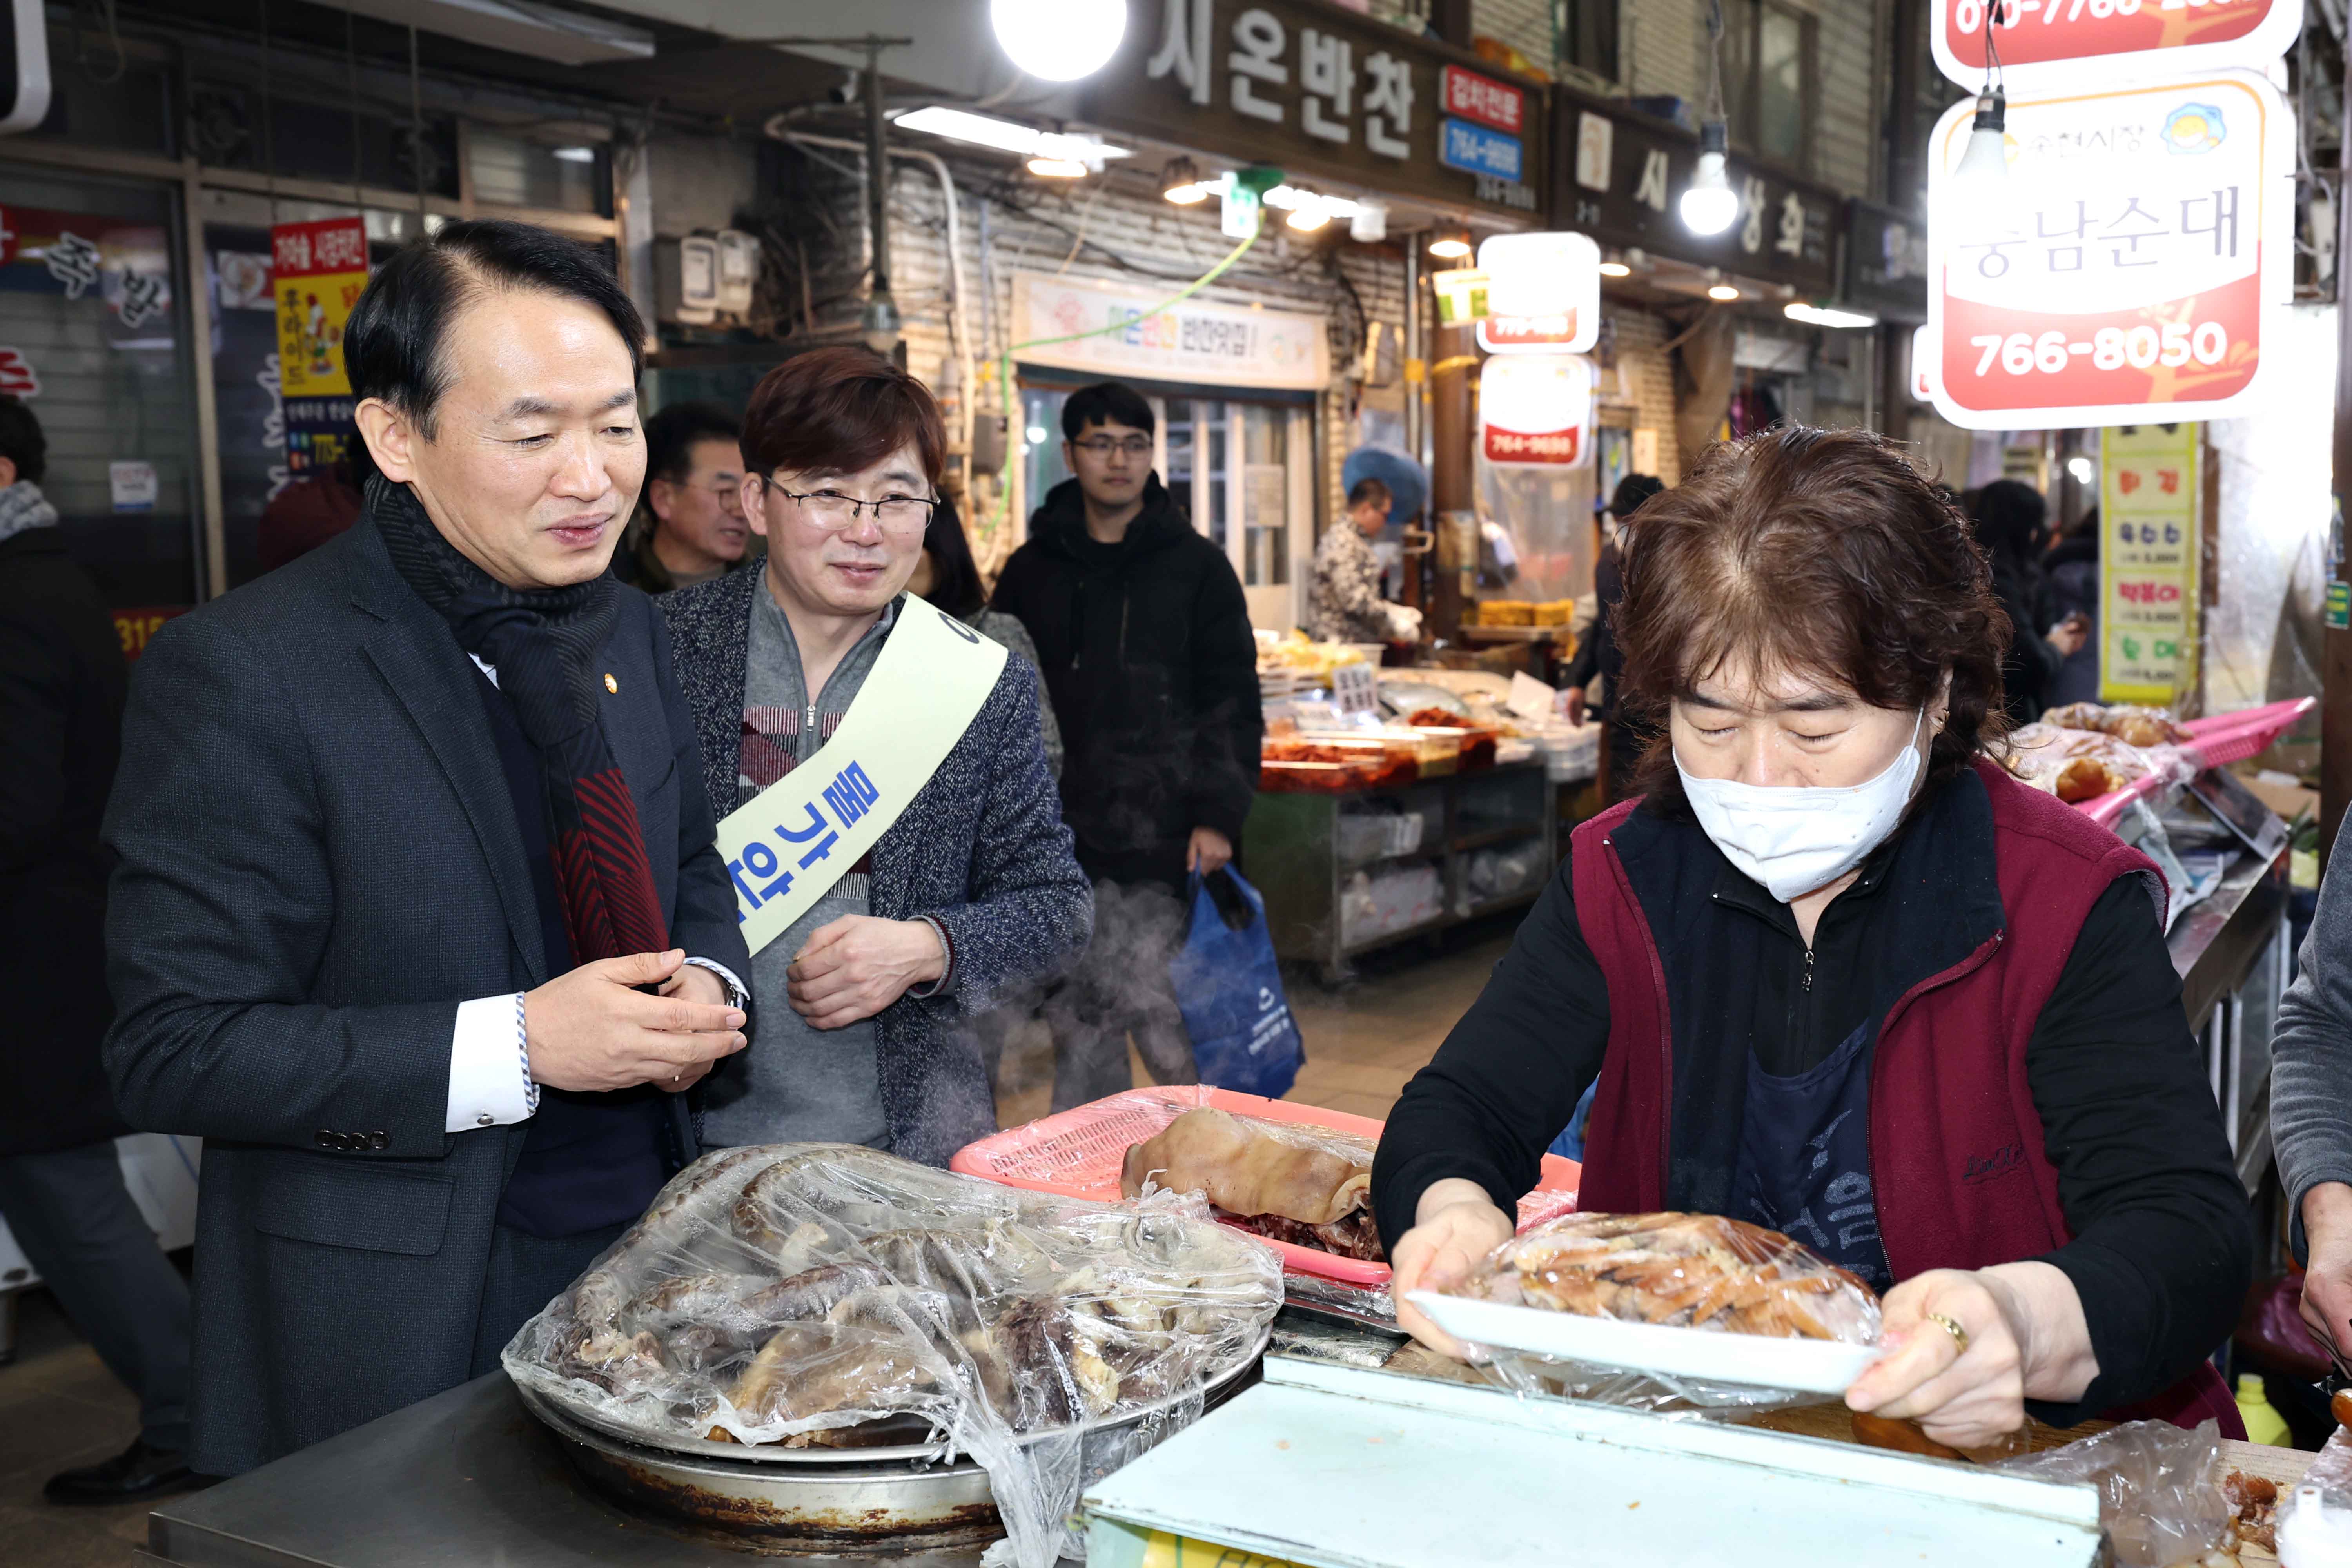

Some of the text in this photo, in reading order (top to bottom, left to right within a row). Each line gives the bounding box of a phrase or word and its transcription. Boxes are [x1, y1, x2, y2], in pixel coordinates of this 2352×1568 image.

[1147, 0, 1414, 160] 시온반찬
[283, 288, 306, 385] 후라이드
[1970, 321, 2227, 377] 766-8050
[725, 760, 880, 923] 물가안
